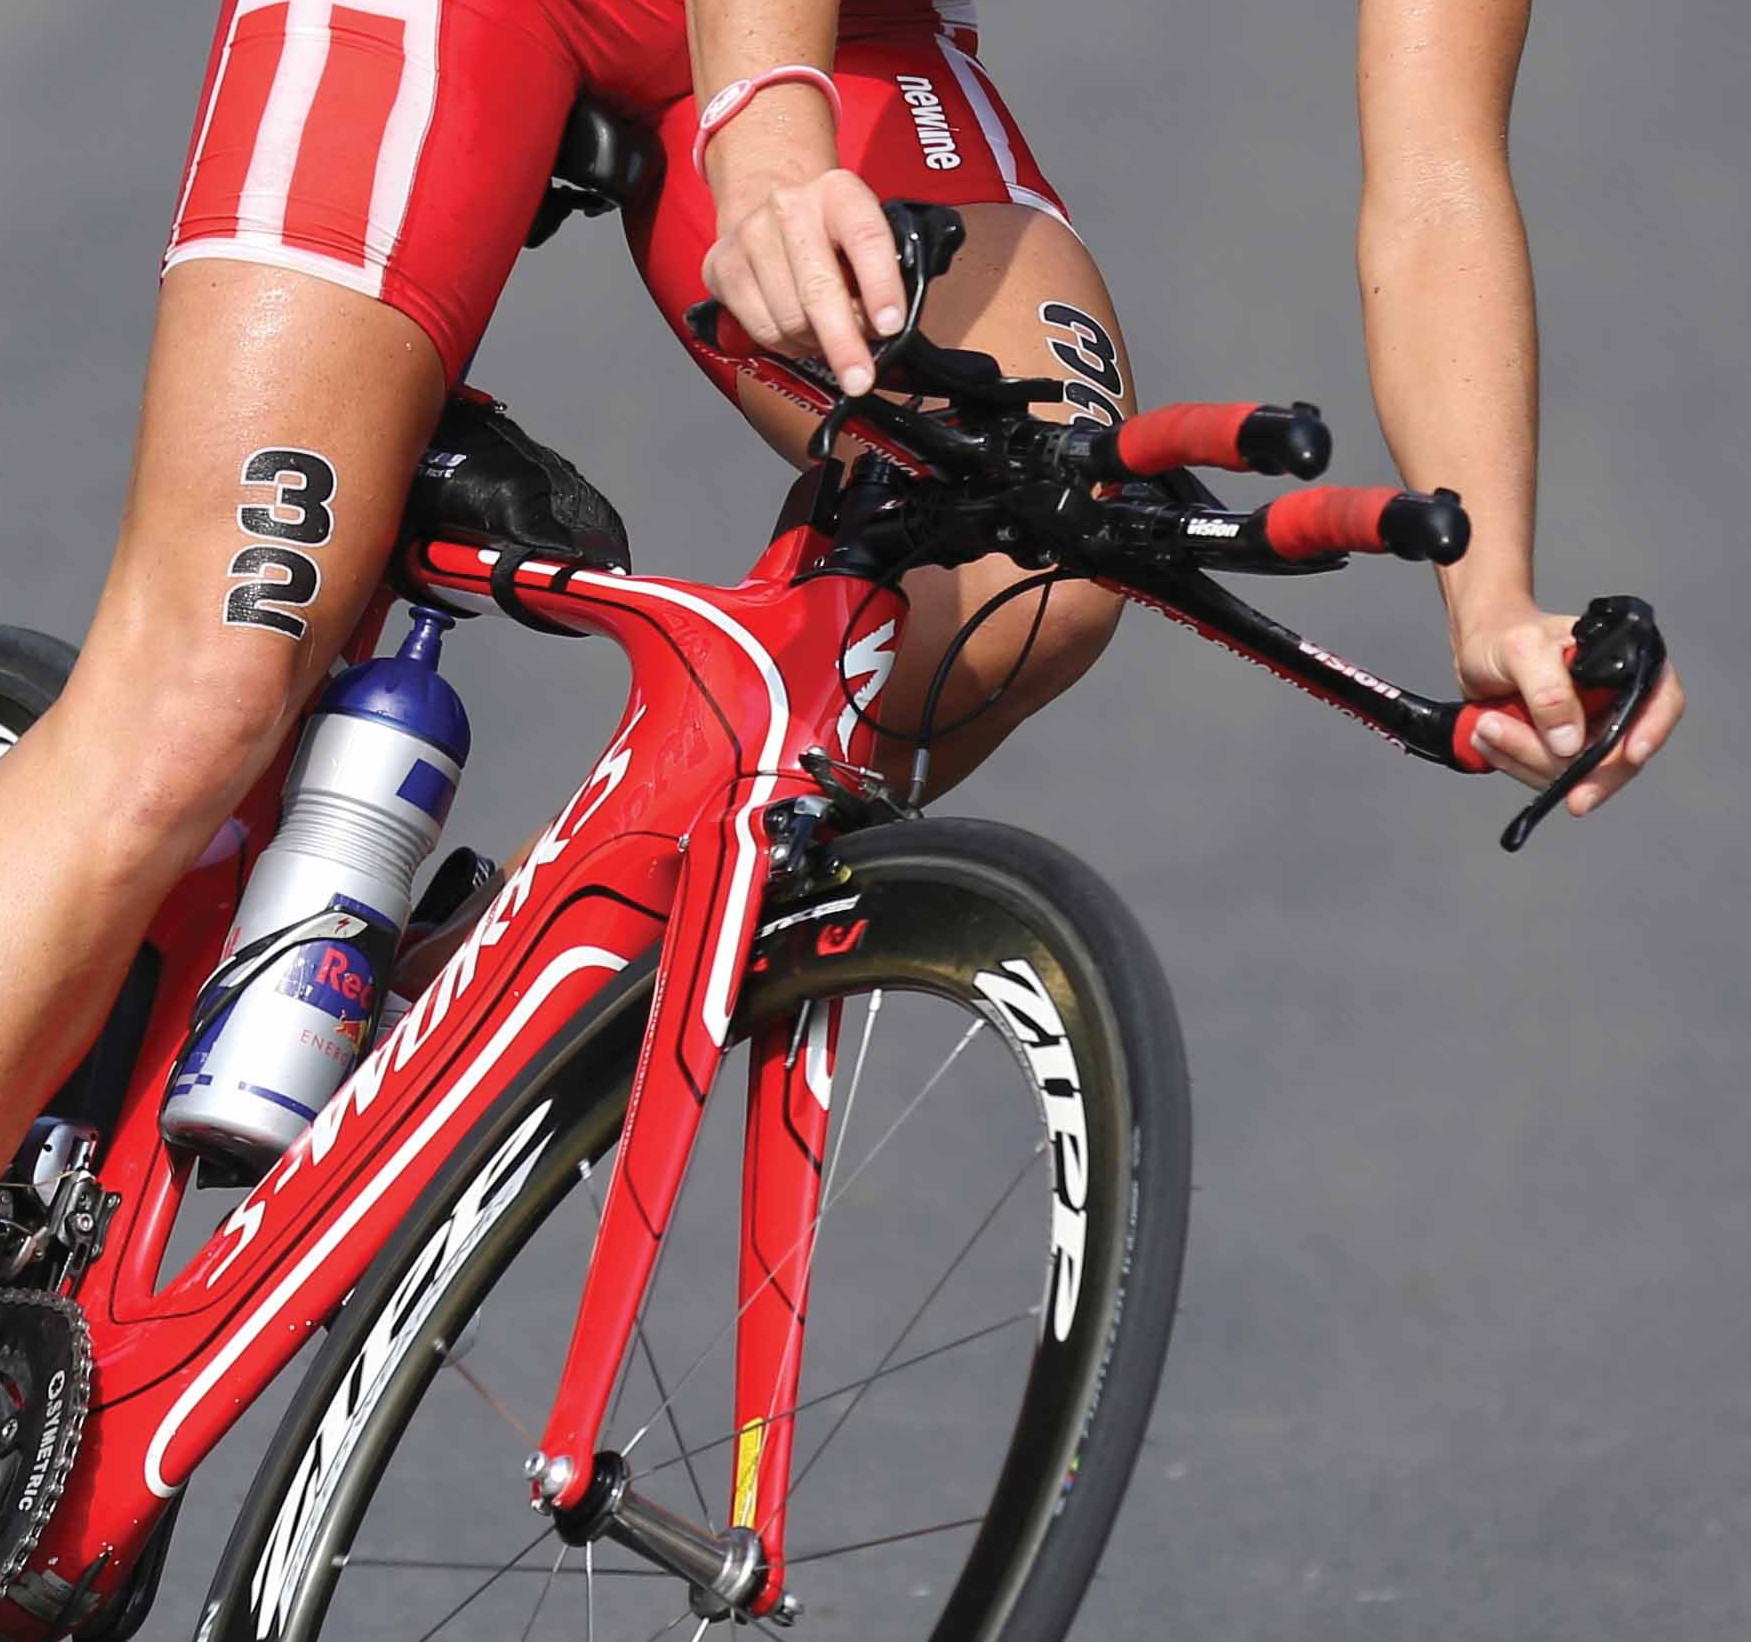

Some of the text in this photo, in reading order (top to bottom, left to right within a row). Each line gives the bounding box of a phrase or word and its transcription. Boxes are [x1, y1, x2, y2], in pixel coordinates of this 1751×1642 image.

[222, 446, 337, 640] 32
[972, 958, 1088, 1342] ZIPP
[251, 1098, 553, 1640] ZIPP
